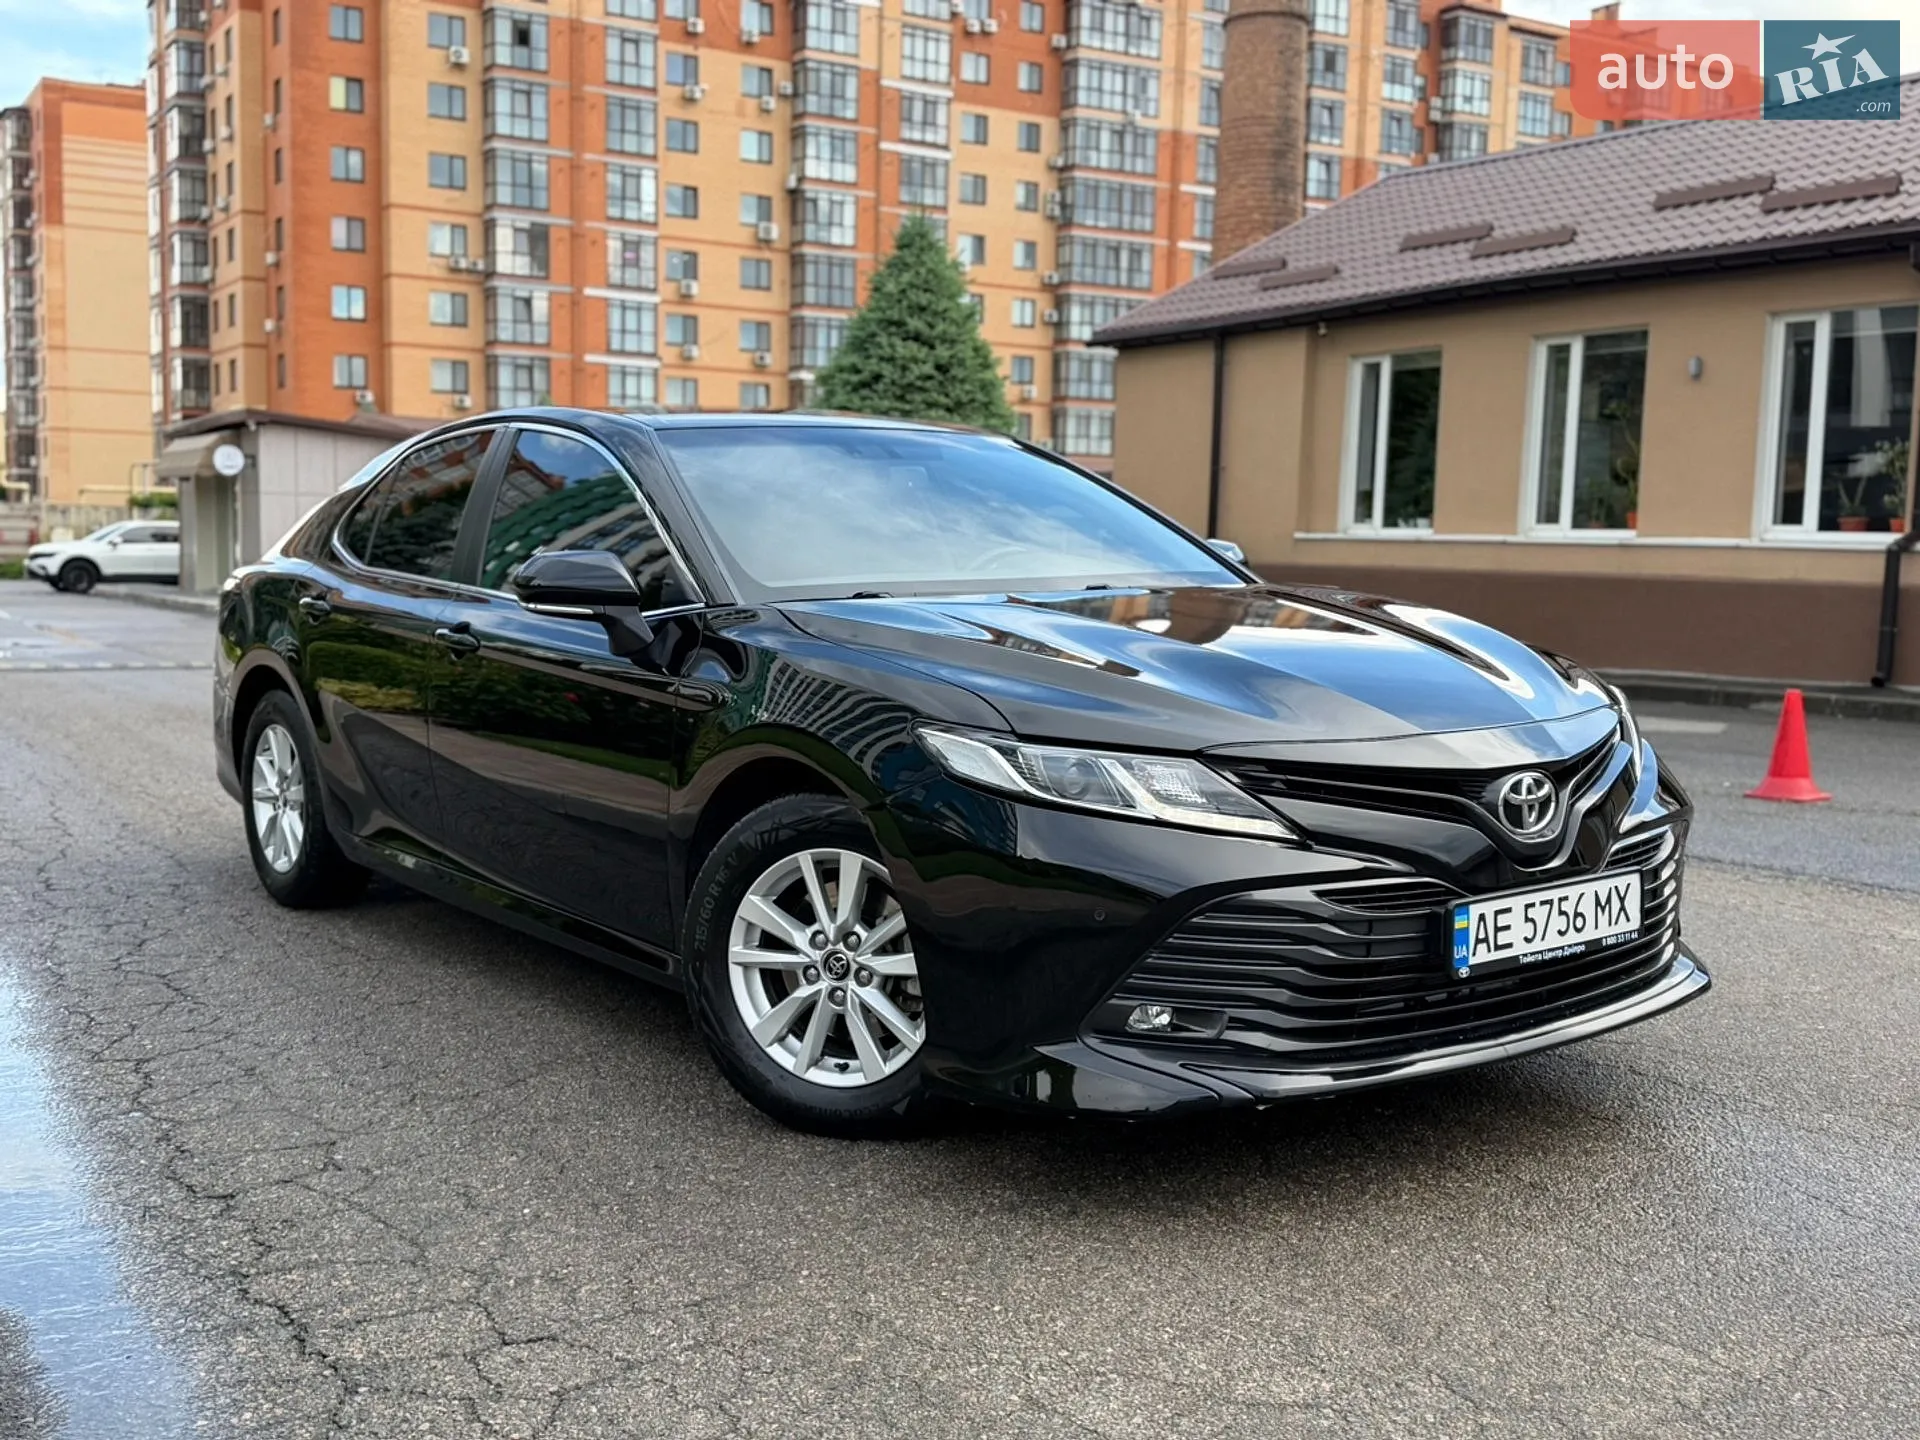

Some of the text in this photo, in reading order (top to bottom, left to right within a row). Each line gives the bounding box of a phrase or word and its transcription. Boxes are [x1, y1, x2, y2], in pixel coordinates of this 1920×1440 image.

[1472, 883, 1631, 957] AE 5756 MX
[1454, 944, 1468, 960] UA
